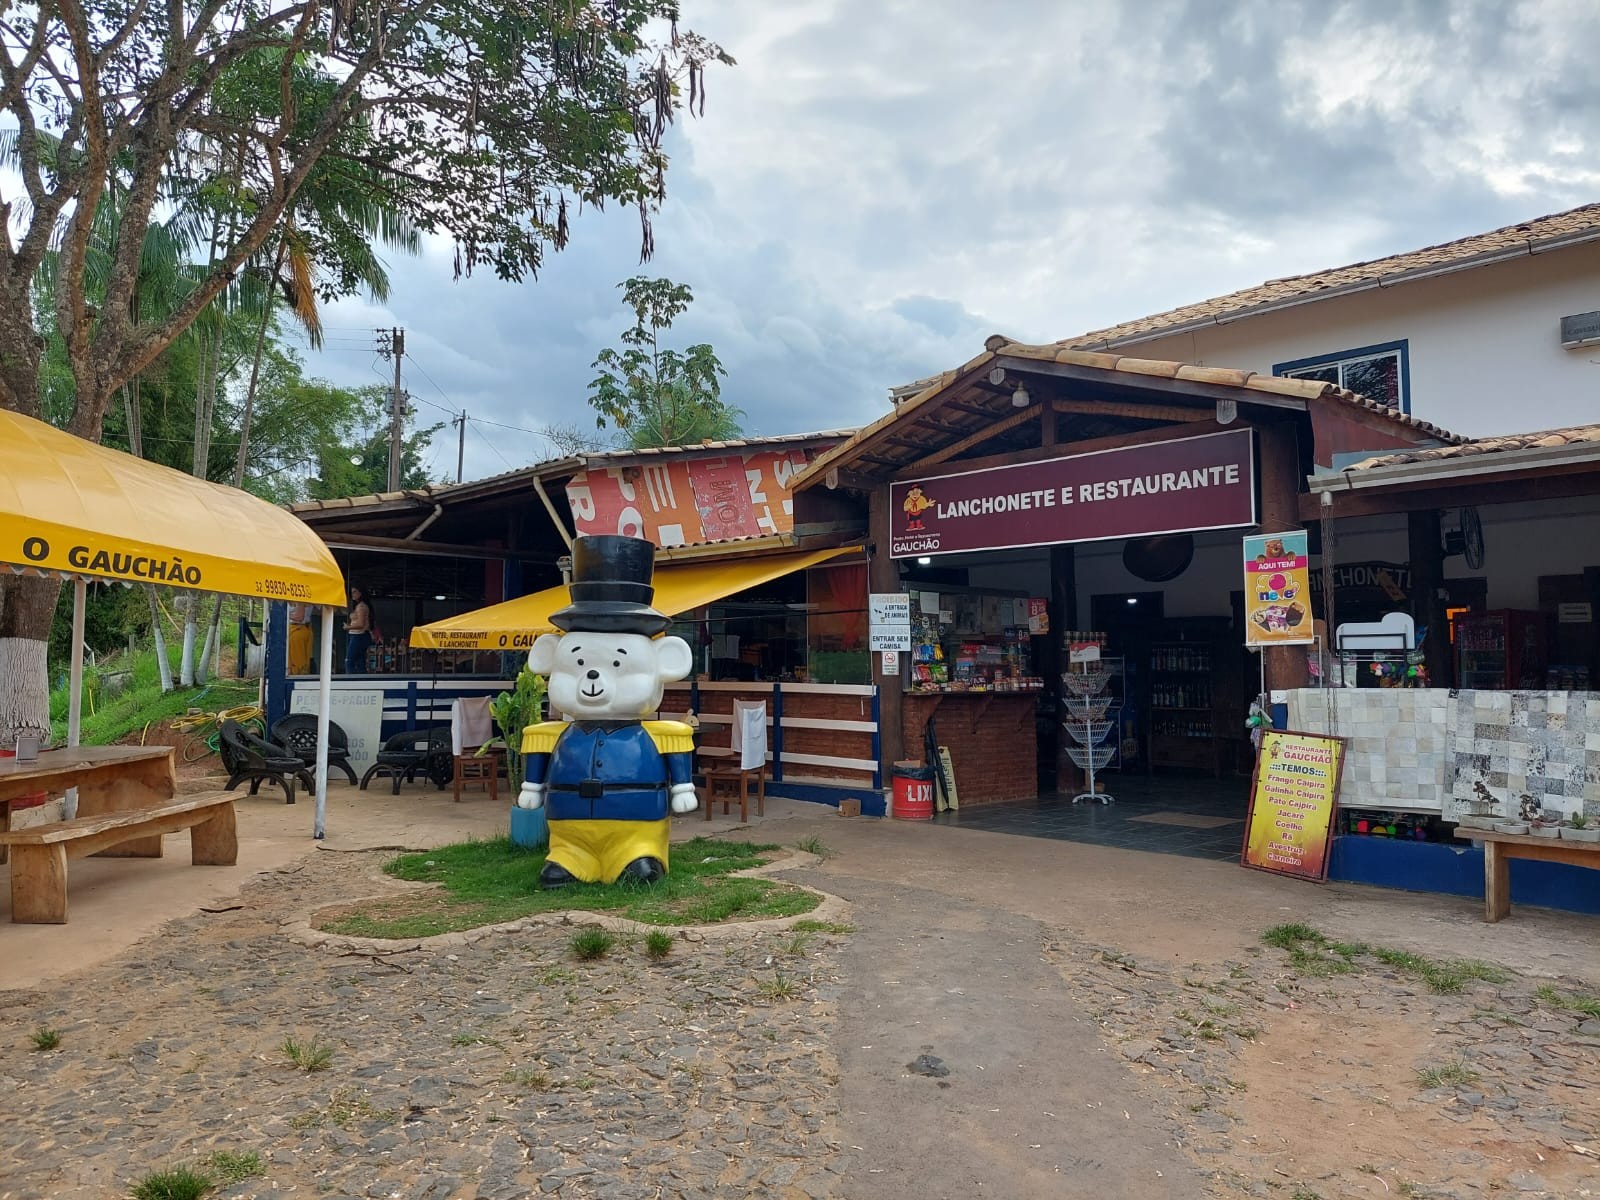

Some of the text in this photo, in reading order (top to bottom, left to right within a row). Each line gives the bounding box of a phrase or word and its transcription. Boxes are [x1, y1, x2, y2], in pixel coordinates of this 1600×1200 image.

[937, 464, 1240, 520] LANCHONETE E RESTAURANTE
[893, 537, 940, 552] GAUCHÃO
[22, 536, 202, 585] O GAUCHÃO
[1258, 560, 1296, 570] AQUI TEM!
[255, 581, 263, 592] 32
[450, 631, 488, 639] RESTAURANTE
[499, 635, 538, 647] O GAU
[444, 640, 478, 648] LANCHONETE
[1285, 744, 1332, 755] RESTAURANTE
[1267, 774, 1325, 789] Frango Caipira
[907, 784, 932, 802] LIX
[1264, 784, 1325, 800] Galinha Caipira
[1269, 796, 1317, 811] Pato Caipira
[1275, 820, 1303, 831] Coelho
[1268, 841, 1303, 855] Avestruz
[1267, 852, 1302, 866] Carneiro
